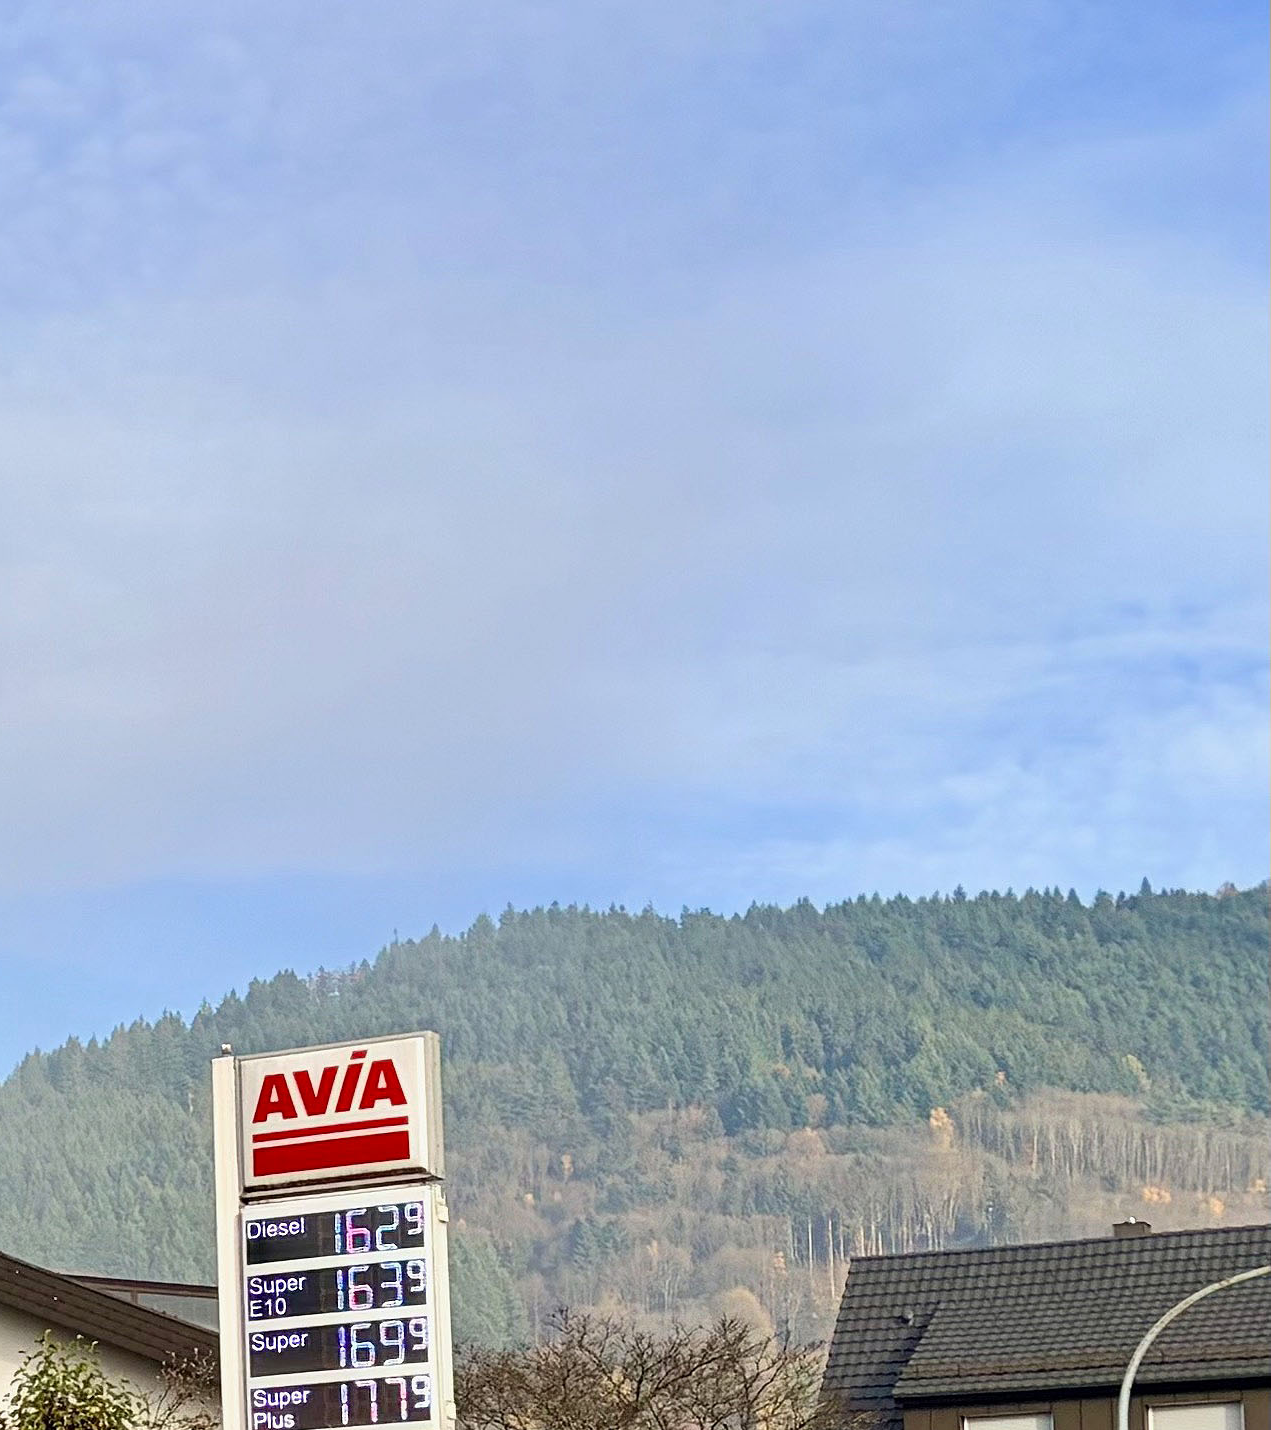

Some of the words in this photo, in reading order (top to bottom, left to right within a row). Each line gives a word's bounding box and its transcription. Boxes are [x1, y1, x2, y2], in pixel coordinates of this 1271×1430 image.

[252, 1050, 408, 1124] AVIA
[246, 1217, 306, 1240] Diesel
[249, 1276, 307, 1298] Super
[249, 1297, 287, 1318] E10
[251, 1332, 309, 1354] Super
[253, 1388, 311, 1410] Super
[254, 1412, 296, 1430] Plus
